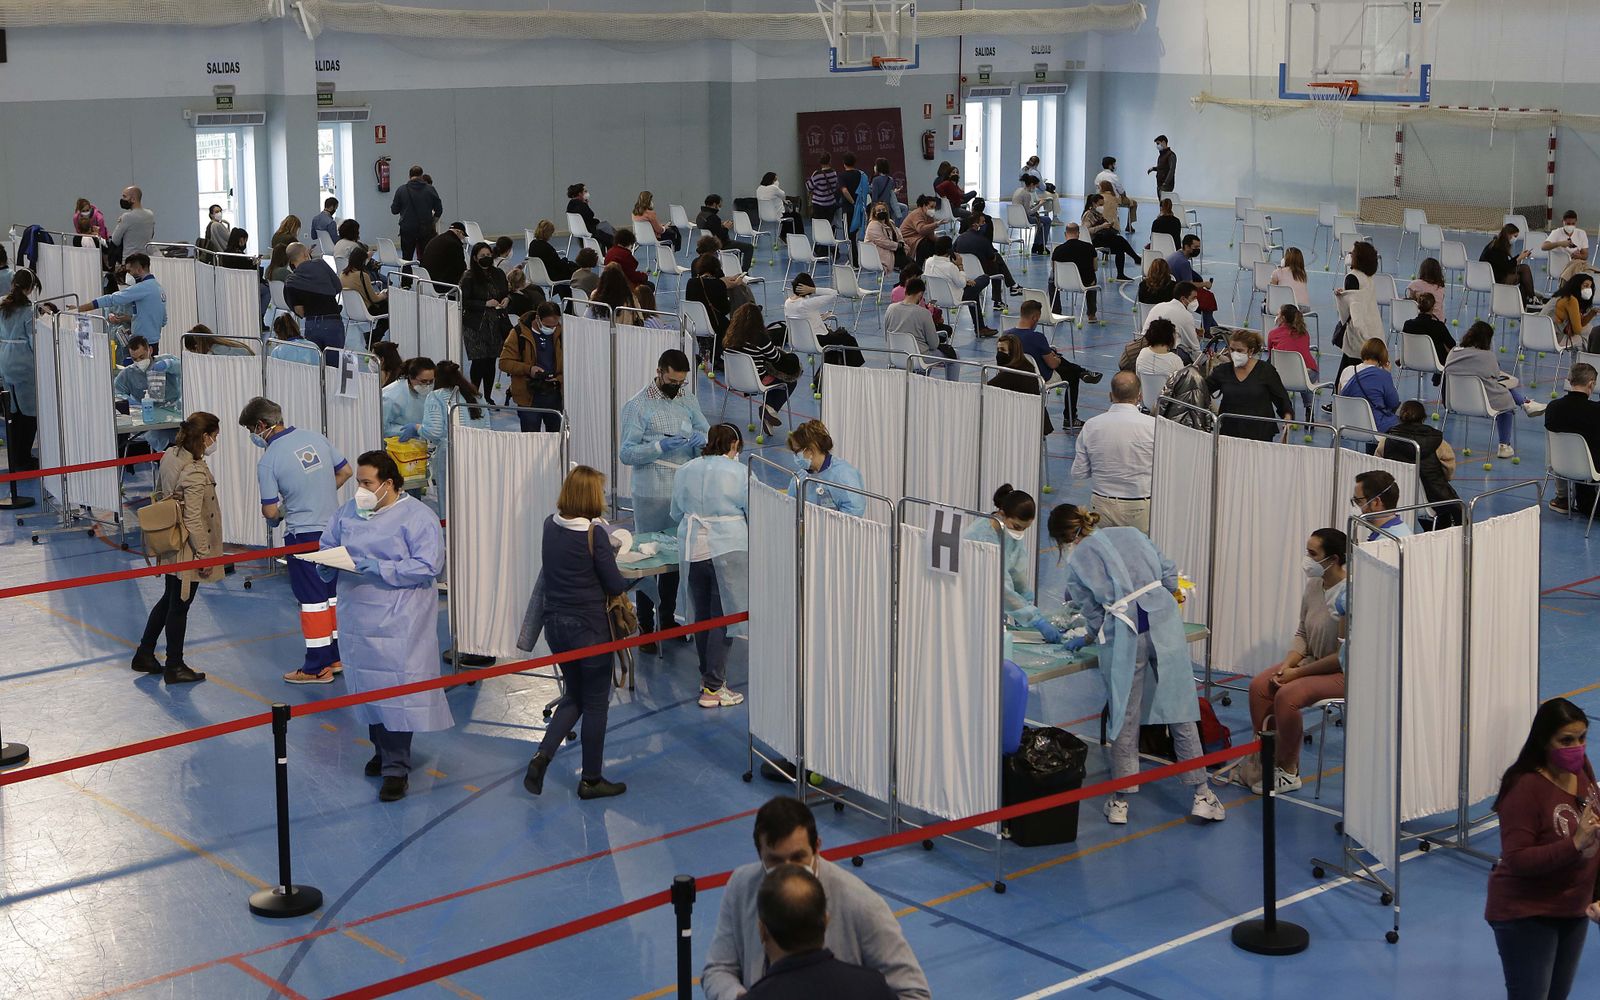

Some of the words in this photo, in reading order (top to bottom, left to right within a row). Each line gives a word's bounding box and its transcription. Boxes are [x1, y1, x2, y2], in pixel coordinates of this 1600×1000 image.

[975, 47, 995, 56] SALIDAS
[206, 62, 240, 74] SALIDAS
[315, 60, 340, 72] ALIDAS
[340, 353, 354, 394] F
[932, 510, 961, 573] H
